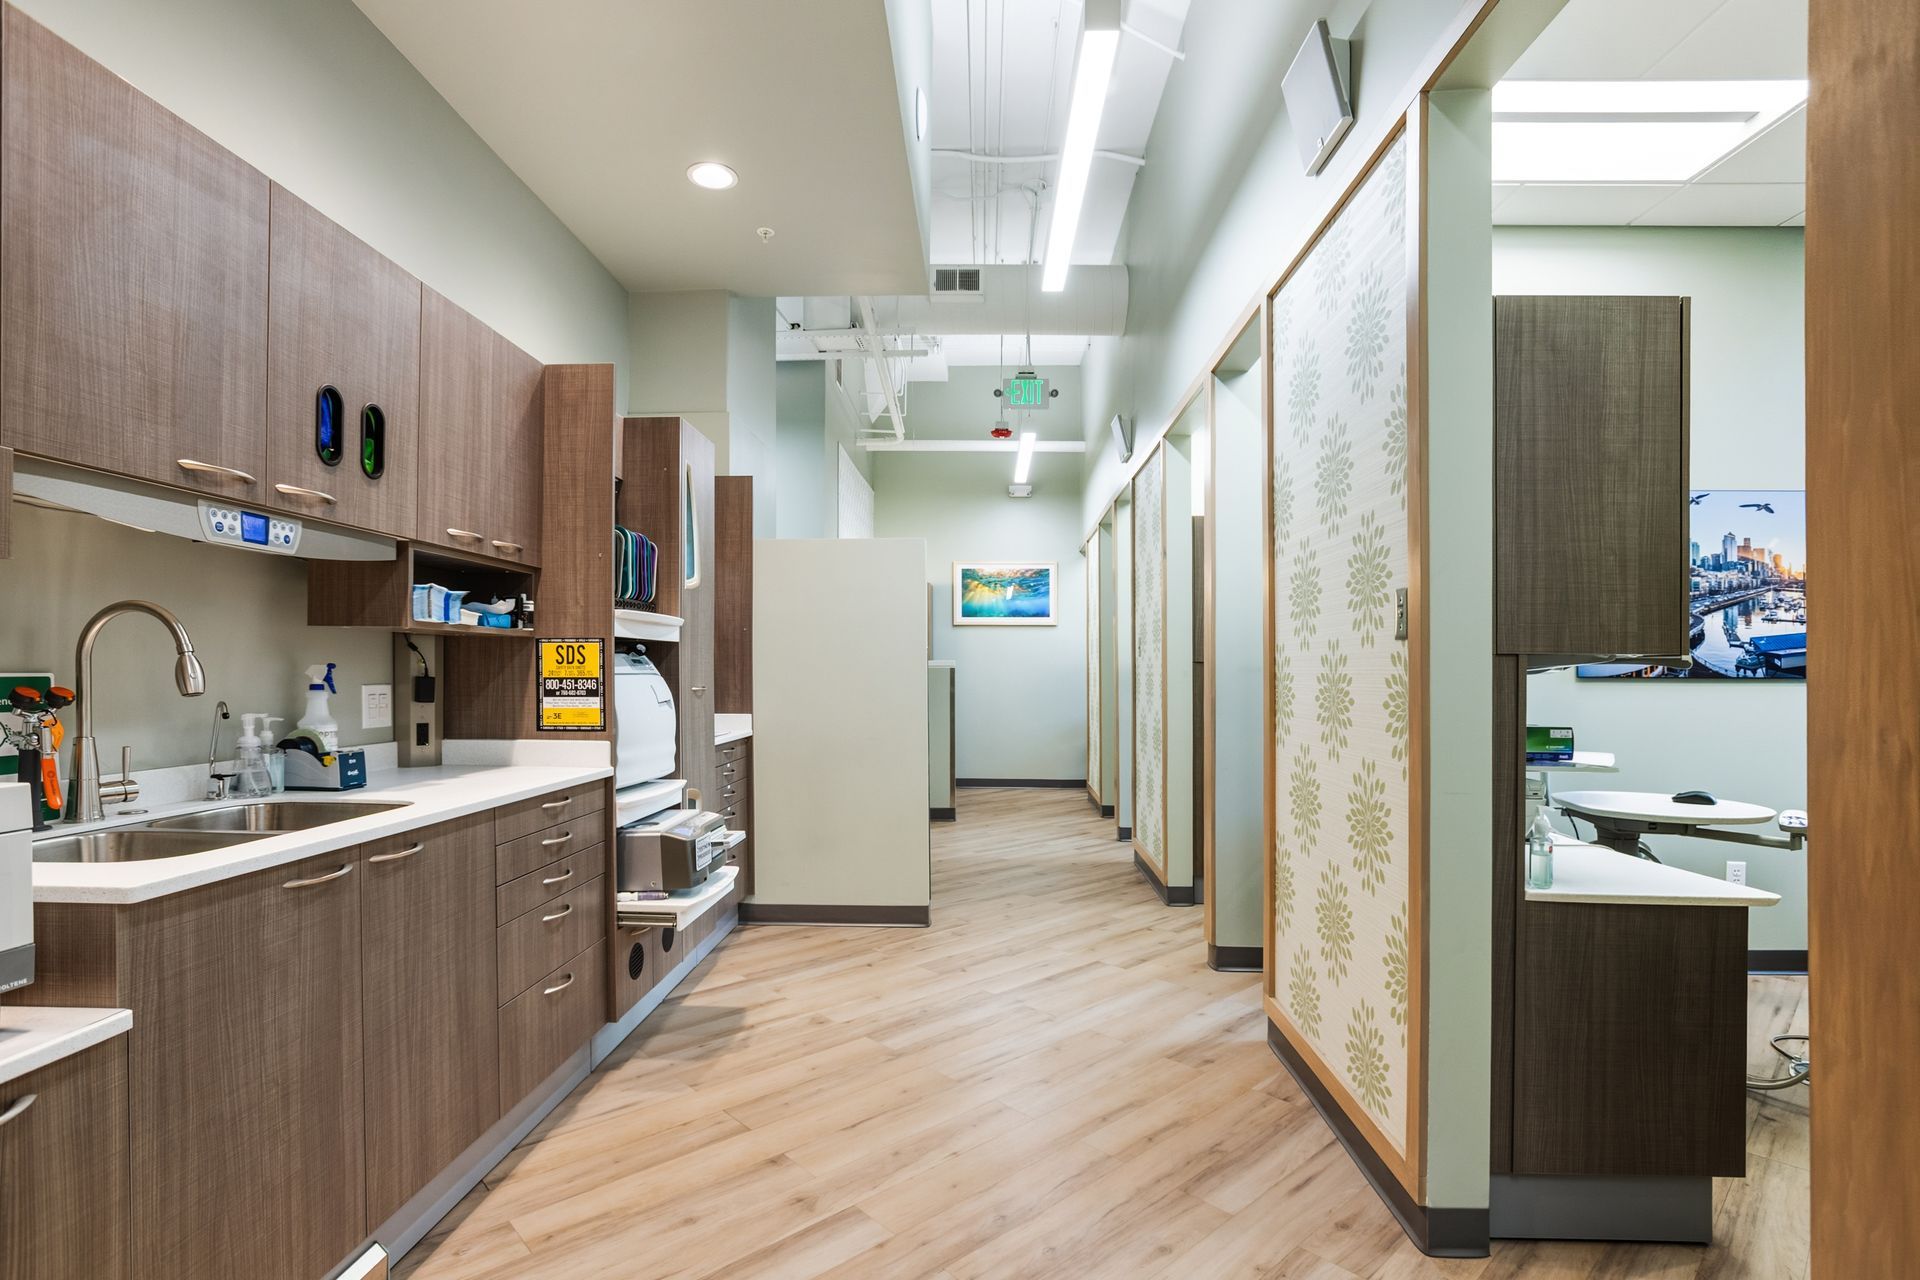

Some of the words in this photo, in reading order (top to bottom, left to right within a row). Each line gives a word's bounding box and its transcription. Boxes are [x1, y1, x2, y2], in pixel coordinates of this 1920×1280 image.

[1011, 379, 1043, 404] EXIT
[555, 644, 586, 665] SDS
[545, 679, 597, 690] 800-451-8346
[0, 978, 27, 990] OLTENE
